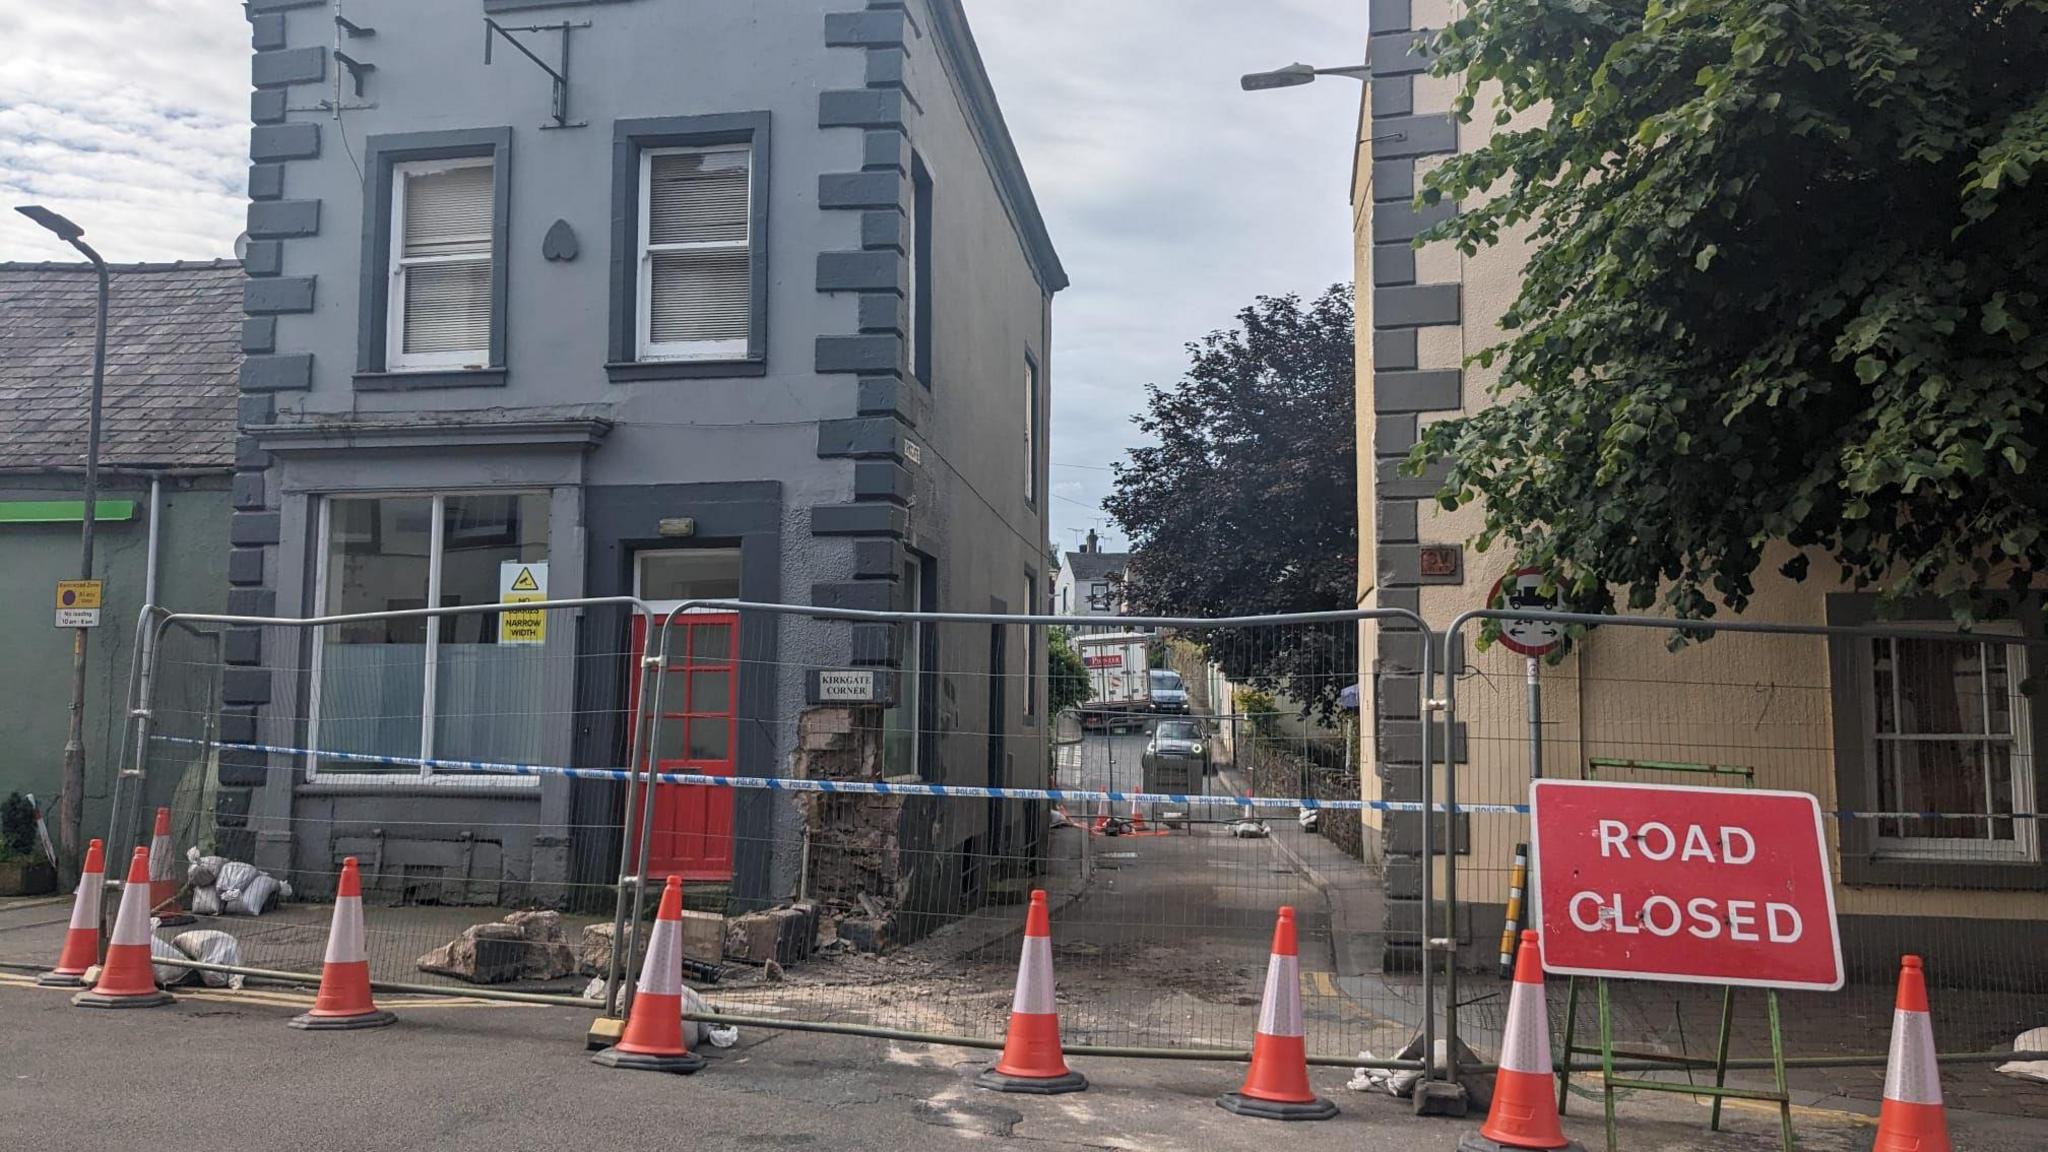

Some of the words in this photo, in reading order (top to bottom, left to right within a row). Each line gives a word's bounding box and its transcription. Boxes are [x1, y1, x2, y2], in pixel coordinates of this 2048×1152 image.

[822, 676, 871, 684] KIRKGATE
[826, 686, 867, 694] CORNER
[1599, 819, 1756, 865] ROAD
[1568, 890, 1803, 944] CLOSED
